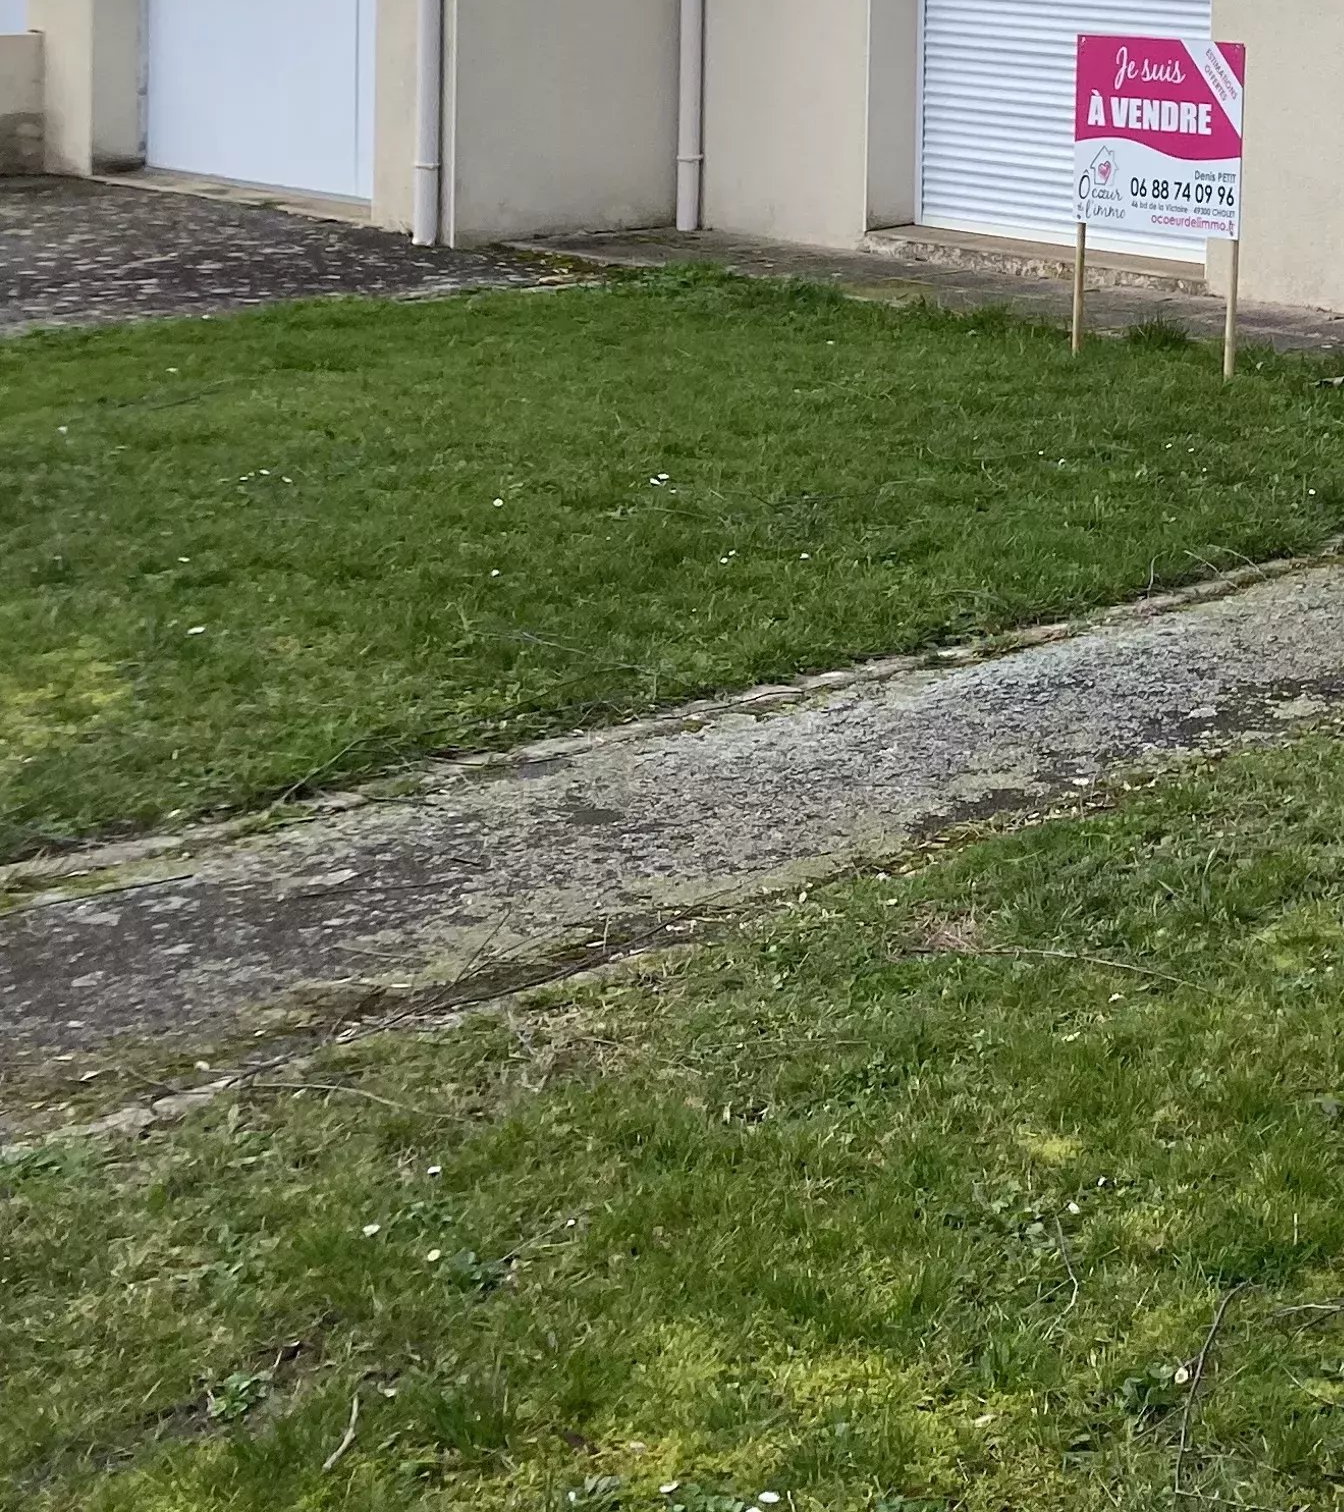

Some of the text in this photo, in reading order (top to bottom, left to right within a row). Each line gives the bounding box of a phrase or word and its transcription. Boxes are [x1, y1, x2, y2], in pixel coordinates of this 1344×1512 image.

[1115, 46, 1186, 90] Je suis
[1087, 88, 1212, 136] À VENDRE
[1195, 170, 1216, 182] Denis
[1130, 177, 1235, 206] 06 88 74 09 96
[1149, 202, 1157, 210] de
